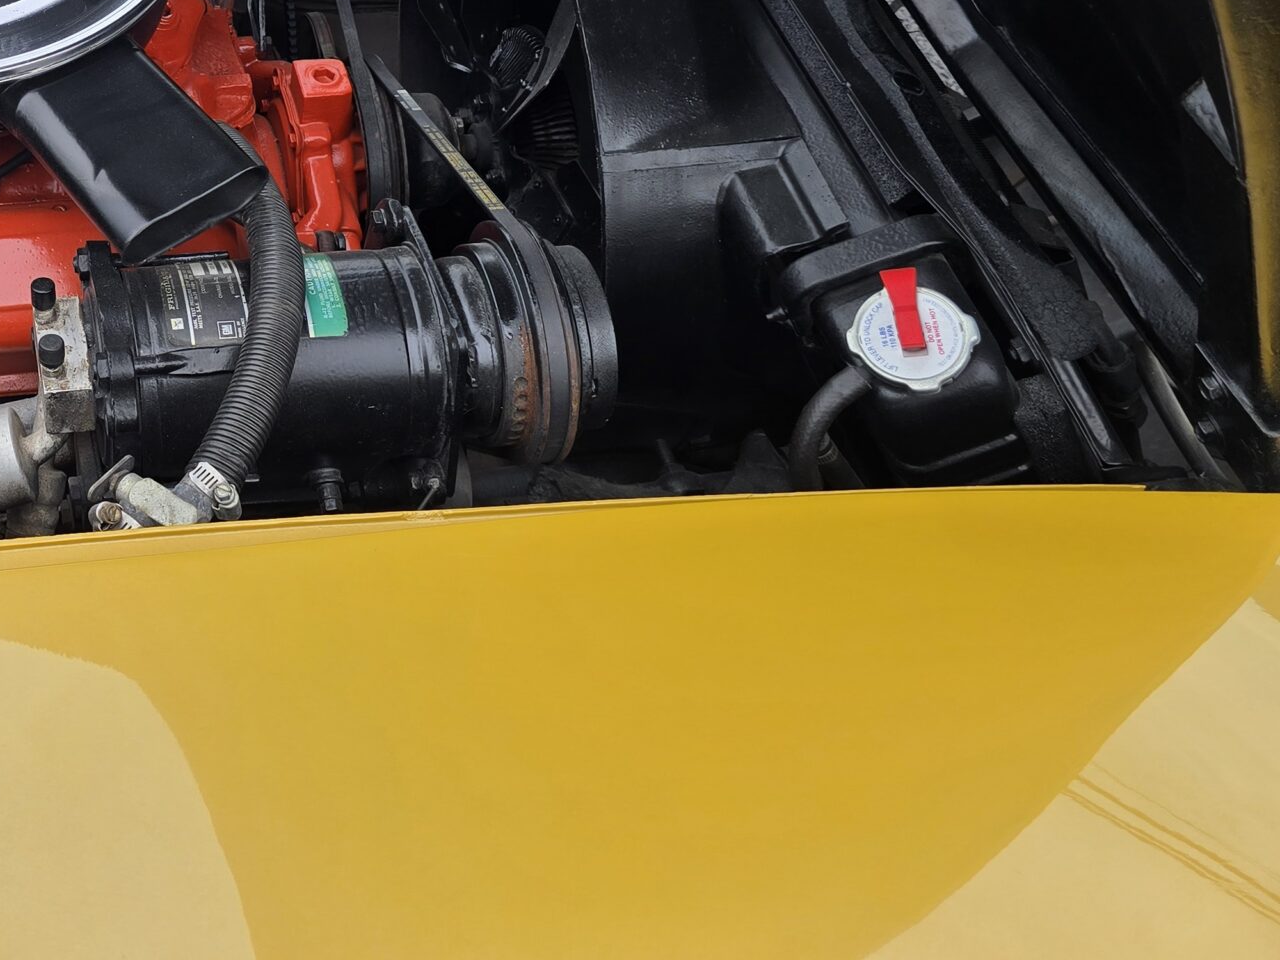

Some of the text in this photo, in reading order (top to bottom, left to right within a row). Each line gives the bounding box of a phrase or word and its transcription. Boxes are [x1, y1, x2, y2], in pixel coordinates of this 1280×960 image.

[879, 326, 887, 339] LBS
[932, 320, 941, 339] WHEN
[864, 337, 872, 346] TO
[936, 339, 945, 355] OPEN
